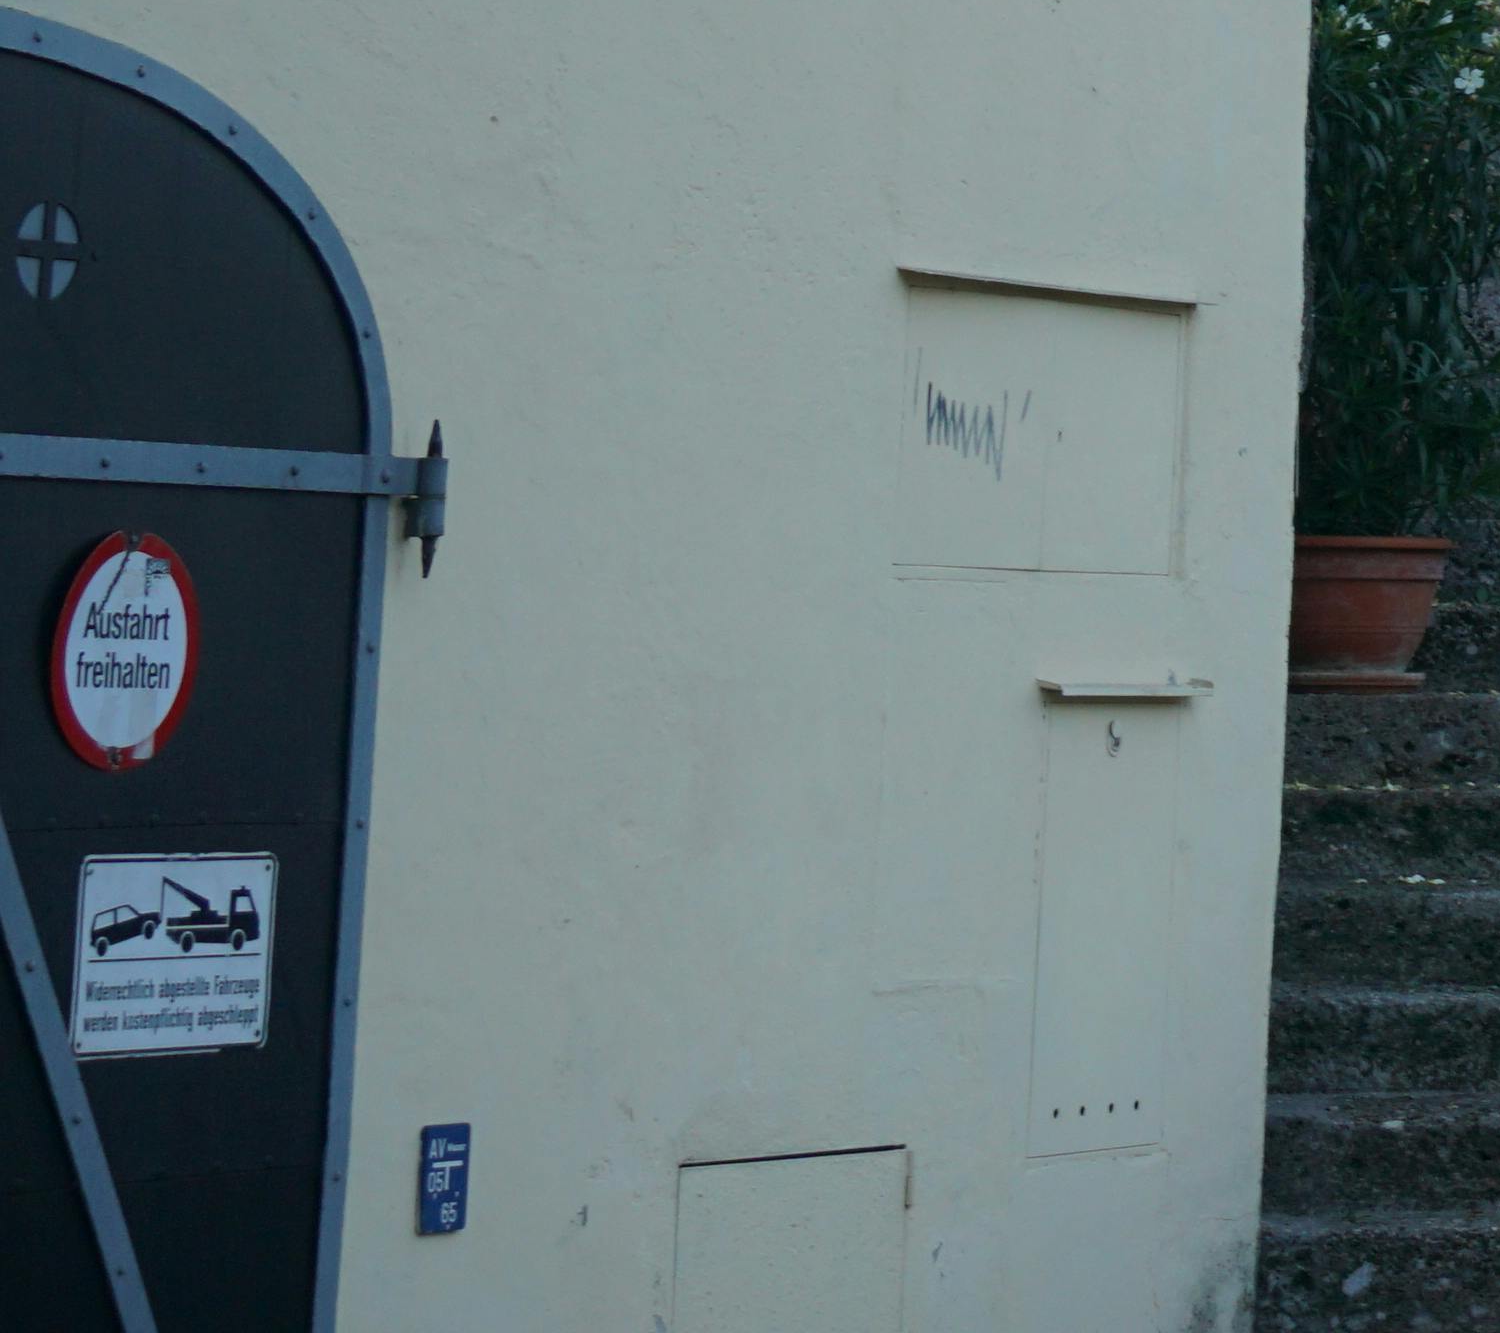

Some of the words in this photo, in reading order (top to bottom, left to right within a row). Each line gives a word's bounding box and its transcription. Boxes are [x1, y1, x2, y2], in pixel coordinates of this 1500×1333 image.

[83, 601, 171, 641] Ausfahrt
[76, 651, 171, 689] freihalten
[158, 976, 210, 1003] abgestellte
[214, 975, 260, 999] Fahrzeuge
[198, 1004, 258, 1031] abgeschleppt
